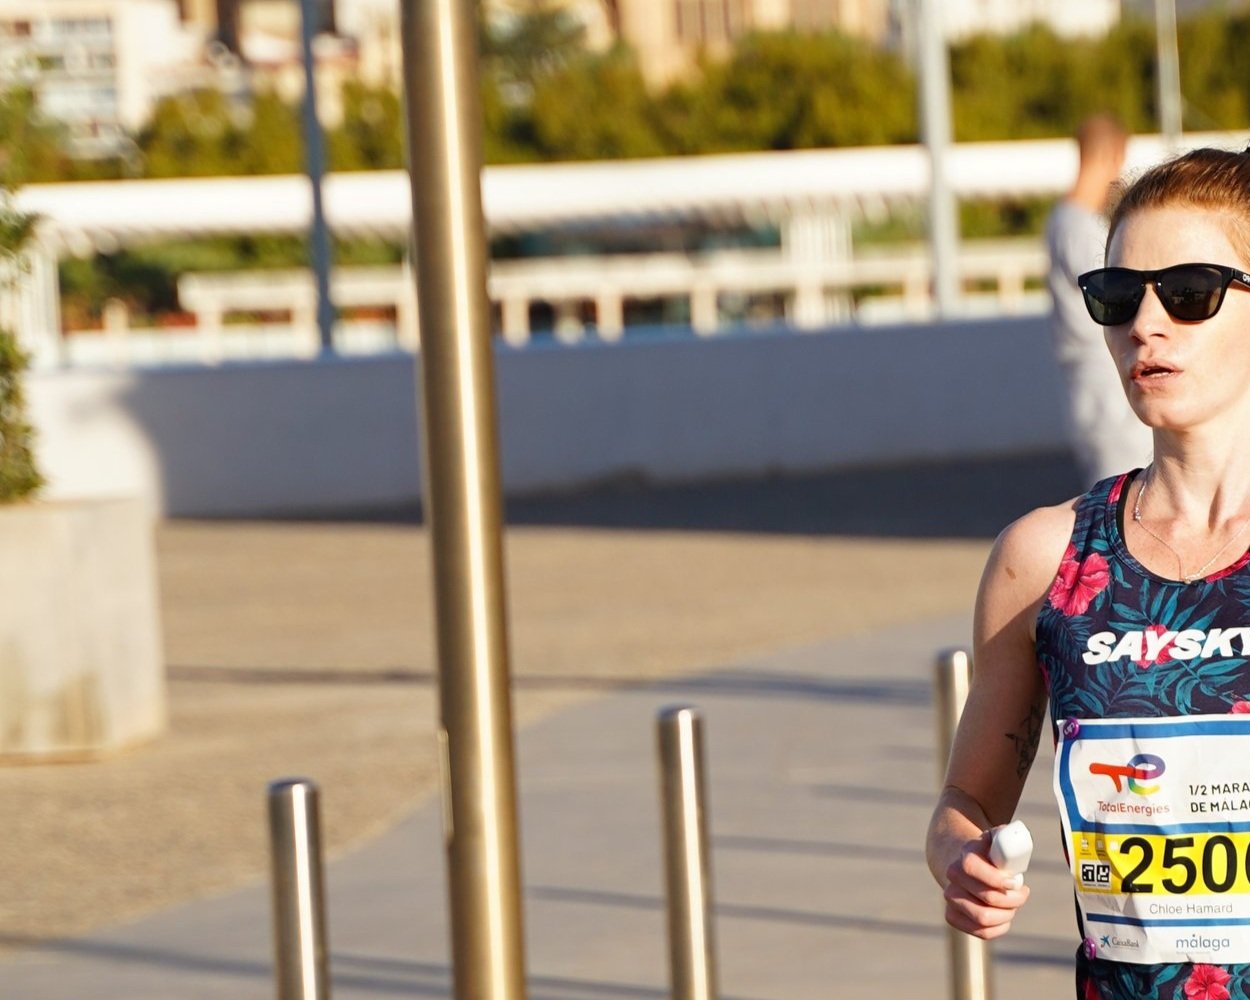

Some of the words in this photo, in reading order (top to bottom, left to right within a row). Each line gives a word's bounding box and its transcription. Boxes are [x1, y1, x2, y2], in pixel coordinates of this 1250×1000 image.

[1189, 784, 1207, 796] 1/2
[1097, 800, 1170, 817] TotalEnergies
[1190, 801, 1207, 813] DE
[1186, 903, 1233, 914] Hamard
[1175, 934, 1230, 951] málaga
